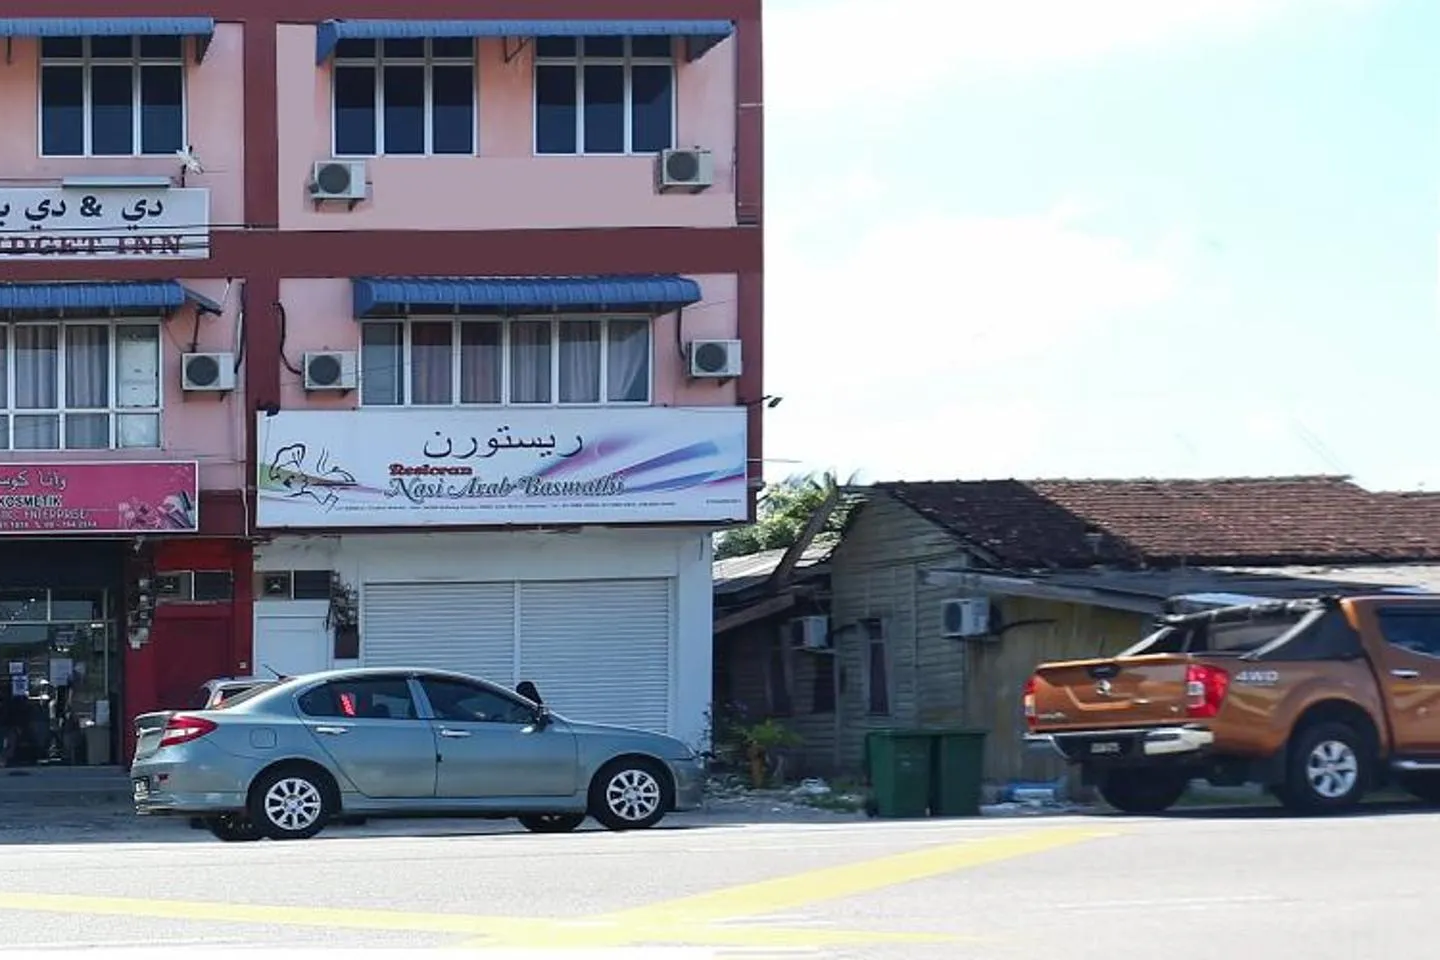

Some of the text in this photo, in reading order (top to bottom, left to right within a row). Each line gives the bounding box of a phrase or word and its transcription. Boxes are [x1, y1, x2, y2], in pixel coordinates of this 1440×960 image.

[80, 195, 103, 217] &
[116, 235, 183, 254] INN
[387, 477, 442, 504] Nasi
[449, 475, 513, 499] Arab
[1235, 670, 1280, 682] 4WD
